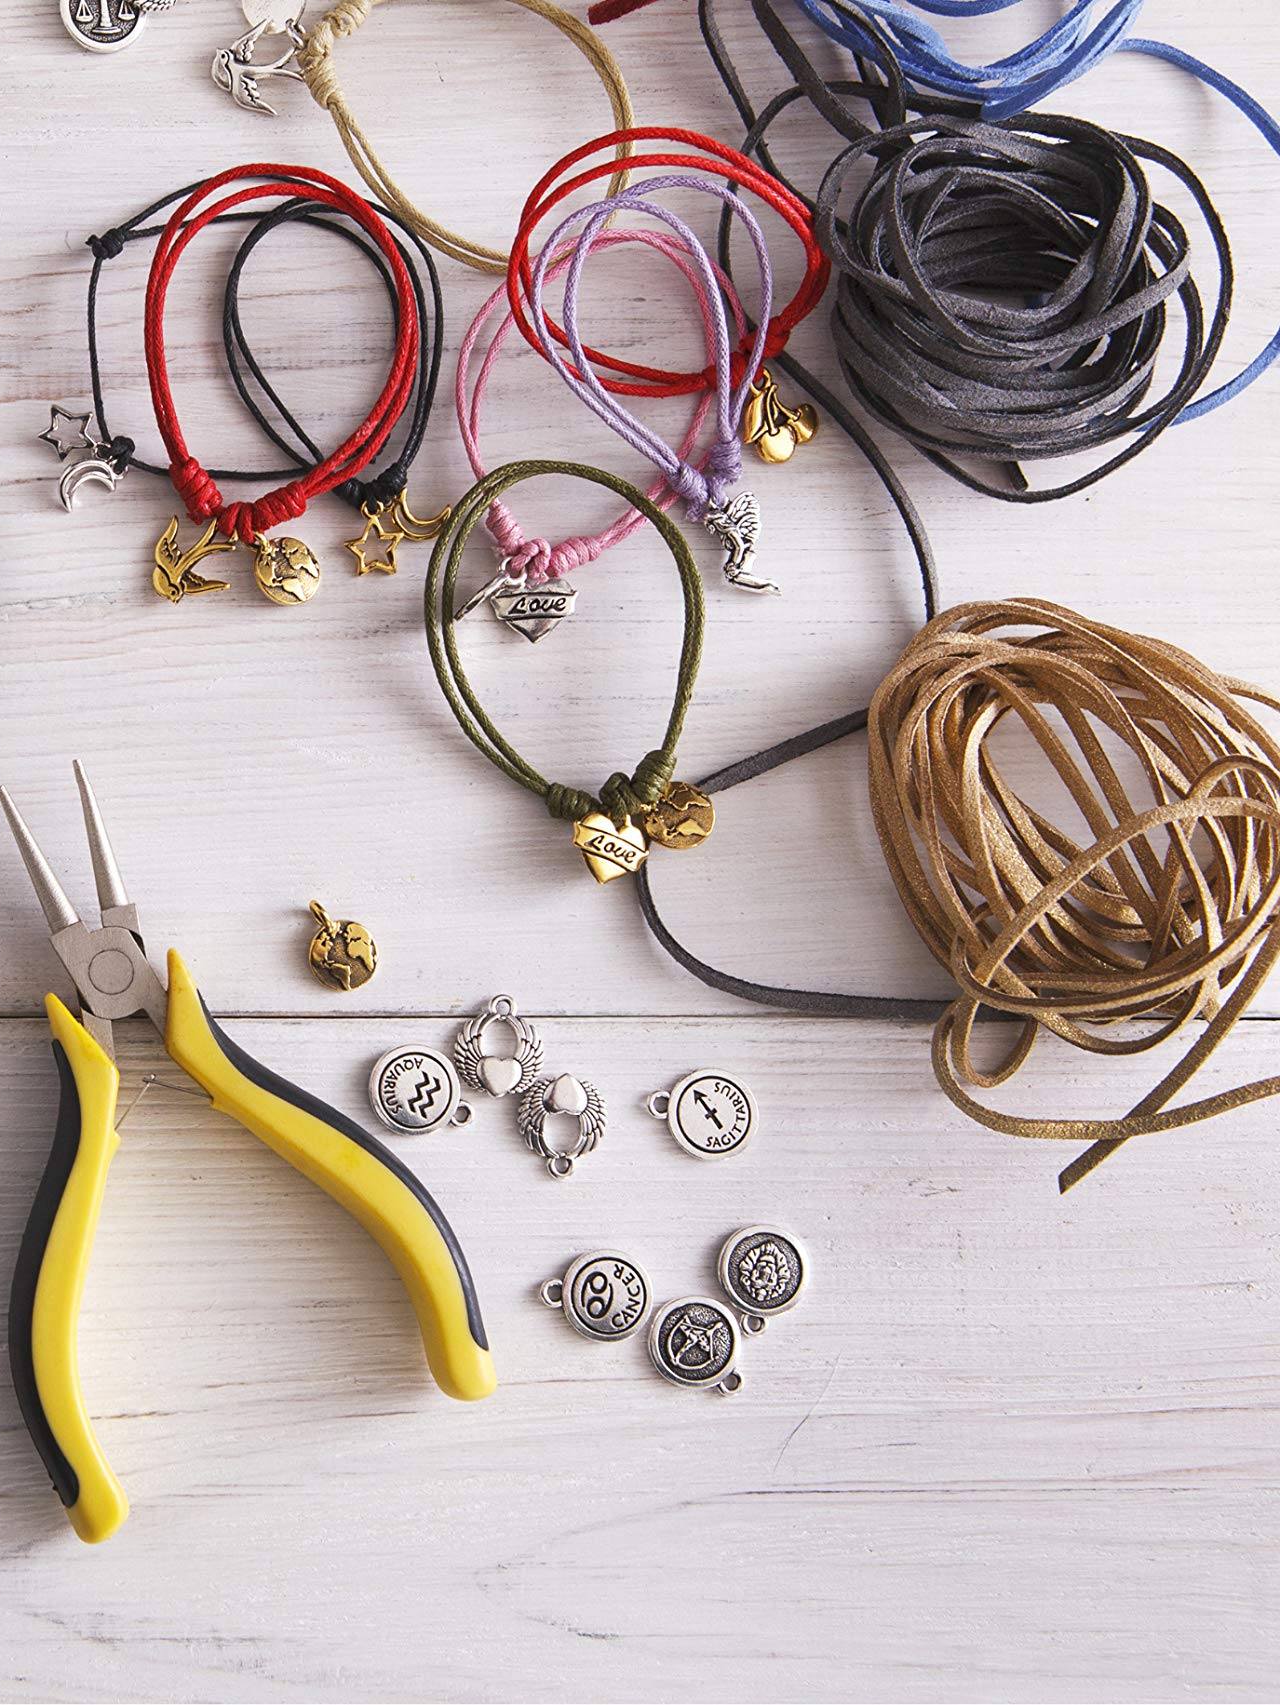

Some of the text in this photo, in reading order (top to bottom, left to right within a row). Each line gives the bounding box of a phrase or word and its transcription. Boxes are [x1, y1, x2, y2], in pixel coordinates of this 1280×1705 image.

[508, 597, 567, 615] Love
[584, 835, 637, 864] Love
[383, 1057, 423, 1115] AQUARIUS
[704, 1081, 747, 1148] SAGITTARIUS
[611, 1263, 642, 1328] CANCER
